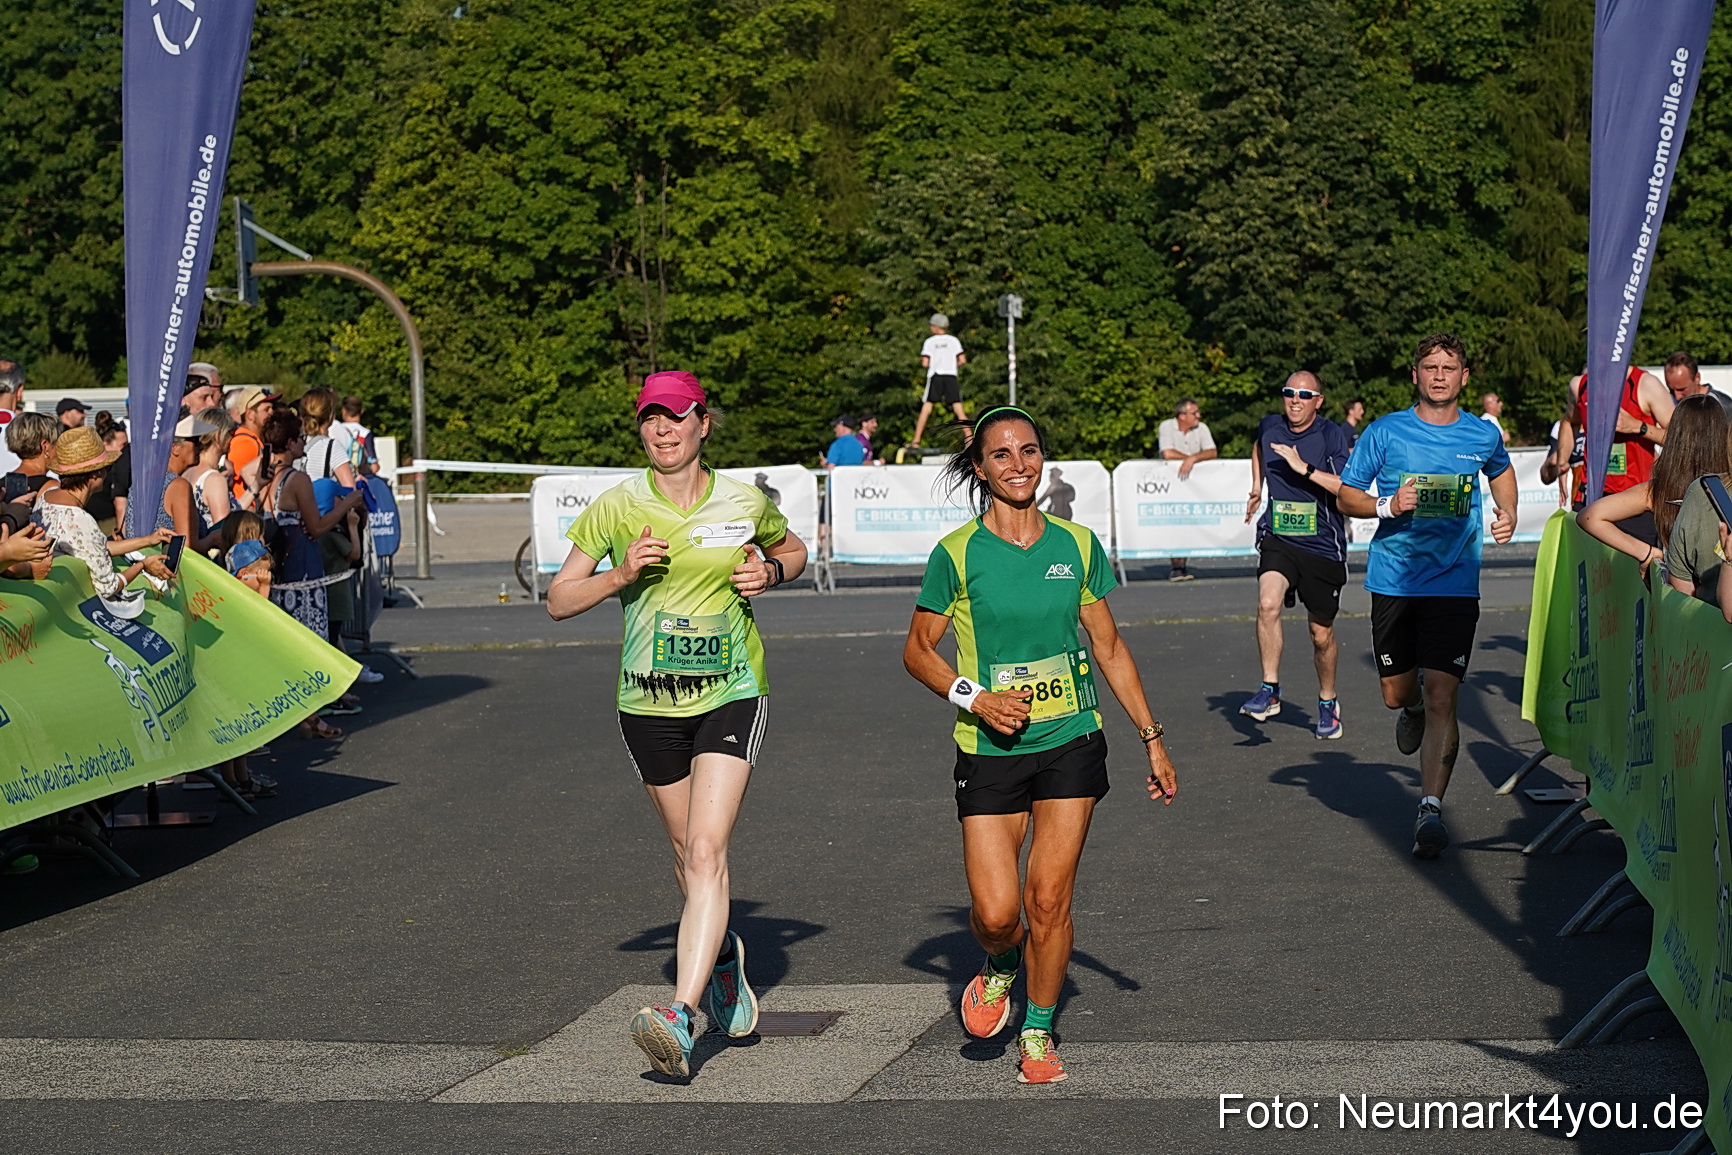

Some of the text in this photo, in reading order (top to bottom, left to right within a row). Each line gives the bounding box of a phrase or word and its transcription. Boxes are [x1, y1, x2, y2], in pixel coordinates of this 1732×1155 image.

[1611, 47, 1690, 363] www.fischer-automobile.de
[151, 134, 217, 440] www.fischer-automobile.de
[854, 487, 889, 499] NOW
[1136, 482, 1170, 494] NOW
[556, 495, 591, 508] NOW
[368, 508, 395, 526] scher
[1282, 513, 1305, 525] 962
[1045, 563, 1075, 576] AOK
[656, 639, 665, 661] RUN
[666, 634, 720, 656] 1320
[721, 637, 729, 666] 2022
[667, 656, 694, 666] Krüger
[1380, 653, 1393, 667] 15
[1009, 677, 1063, 704] 986
[1063, 677, 1074, 707] 2022
